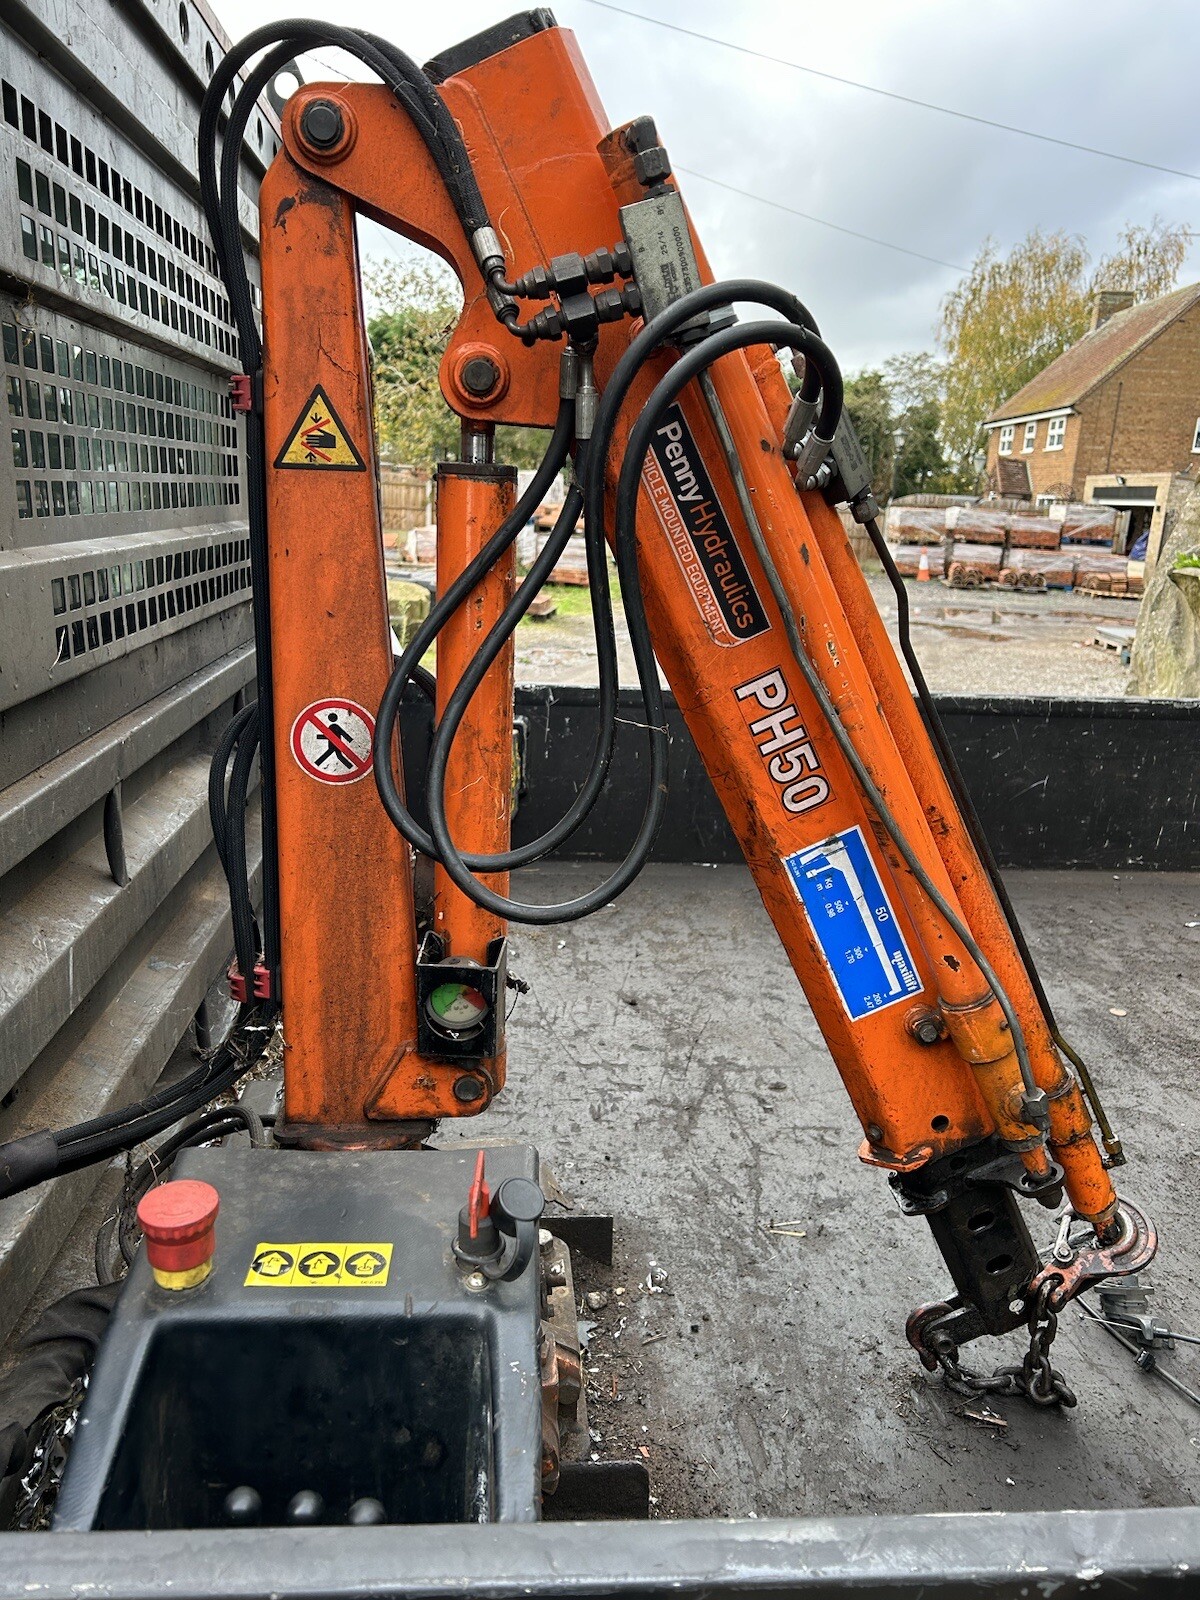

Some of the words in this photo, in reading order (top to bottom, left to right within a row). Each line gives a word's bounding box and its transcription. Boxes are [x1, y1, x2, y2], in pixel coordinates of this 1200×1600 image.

[657, 421, 705, 502] Penny
[689, 500, 754, 629] Hydraulics
[658, 500, 694, 562] MOUNTED
[686, 566, 726, 636] EQUIPMENT
[733, 668, 830, 814] PH50
[816, 883, 824, 891] m
[824, 902, 836, 918] 0.98
[845, 949, 855, 963] 1.70
[863, 995, 874, 1009] 2.47
[824, 877, 833, 889] Kg
[833, 899, 844, 913] 500
[853, 945, 864, 959] 300
[872, 992, 882, 1005] 200
[874, 906, 889, 922] 50
[890, 950, 918, 991] maxilift
